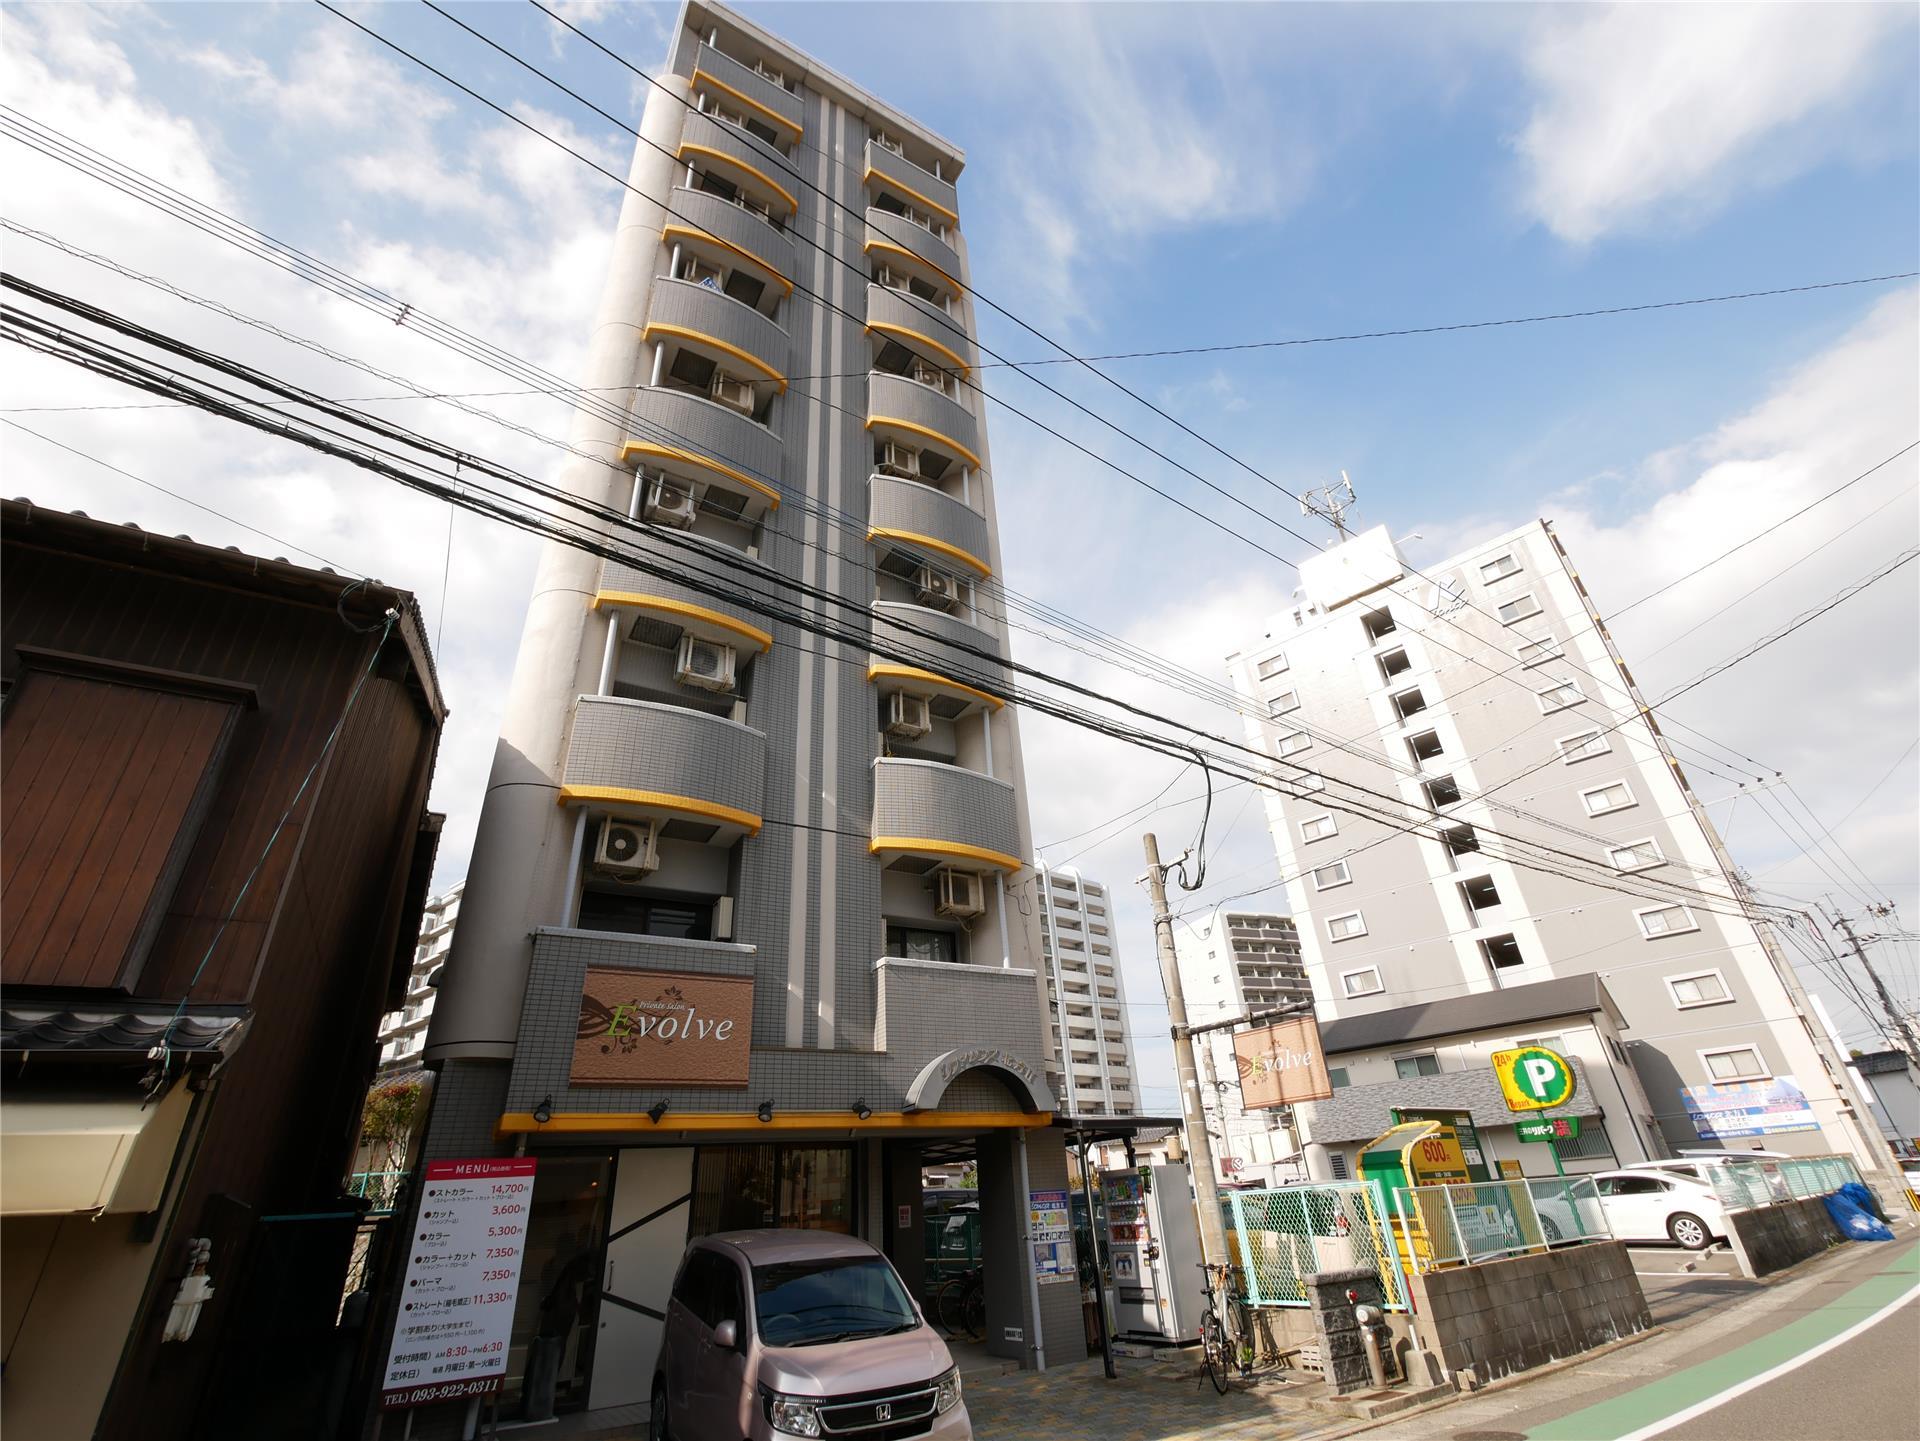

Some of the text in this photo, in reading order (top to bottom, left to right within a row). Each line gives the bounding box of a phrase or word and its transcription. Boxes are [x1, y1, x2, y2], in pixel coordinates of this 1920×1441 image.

[600, 1004, 734, 1041] Evolve
[1252, 1049, 1312, 1075] Evolve
[1523, 1058, 1556, 1097] P
[455, 1164, 490, 1174] MENU
[435, 1188, 474, 1197] ストカラー
[432, 1211, 454, 1219] カット
[426, 1233, 450, 1241] カラー
[411, 1378, 499, 1402] 093-922-0311
